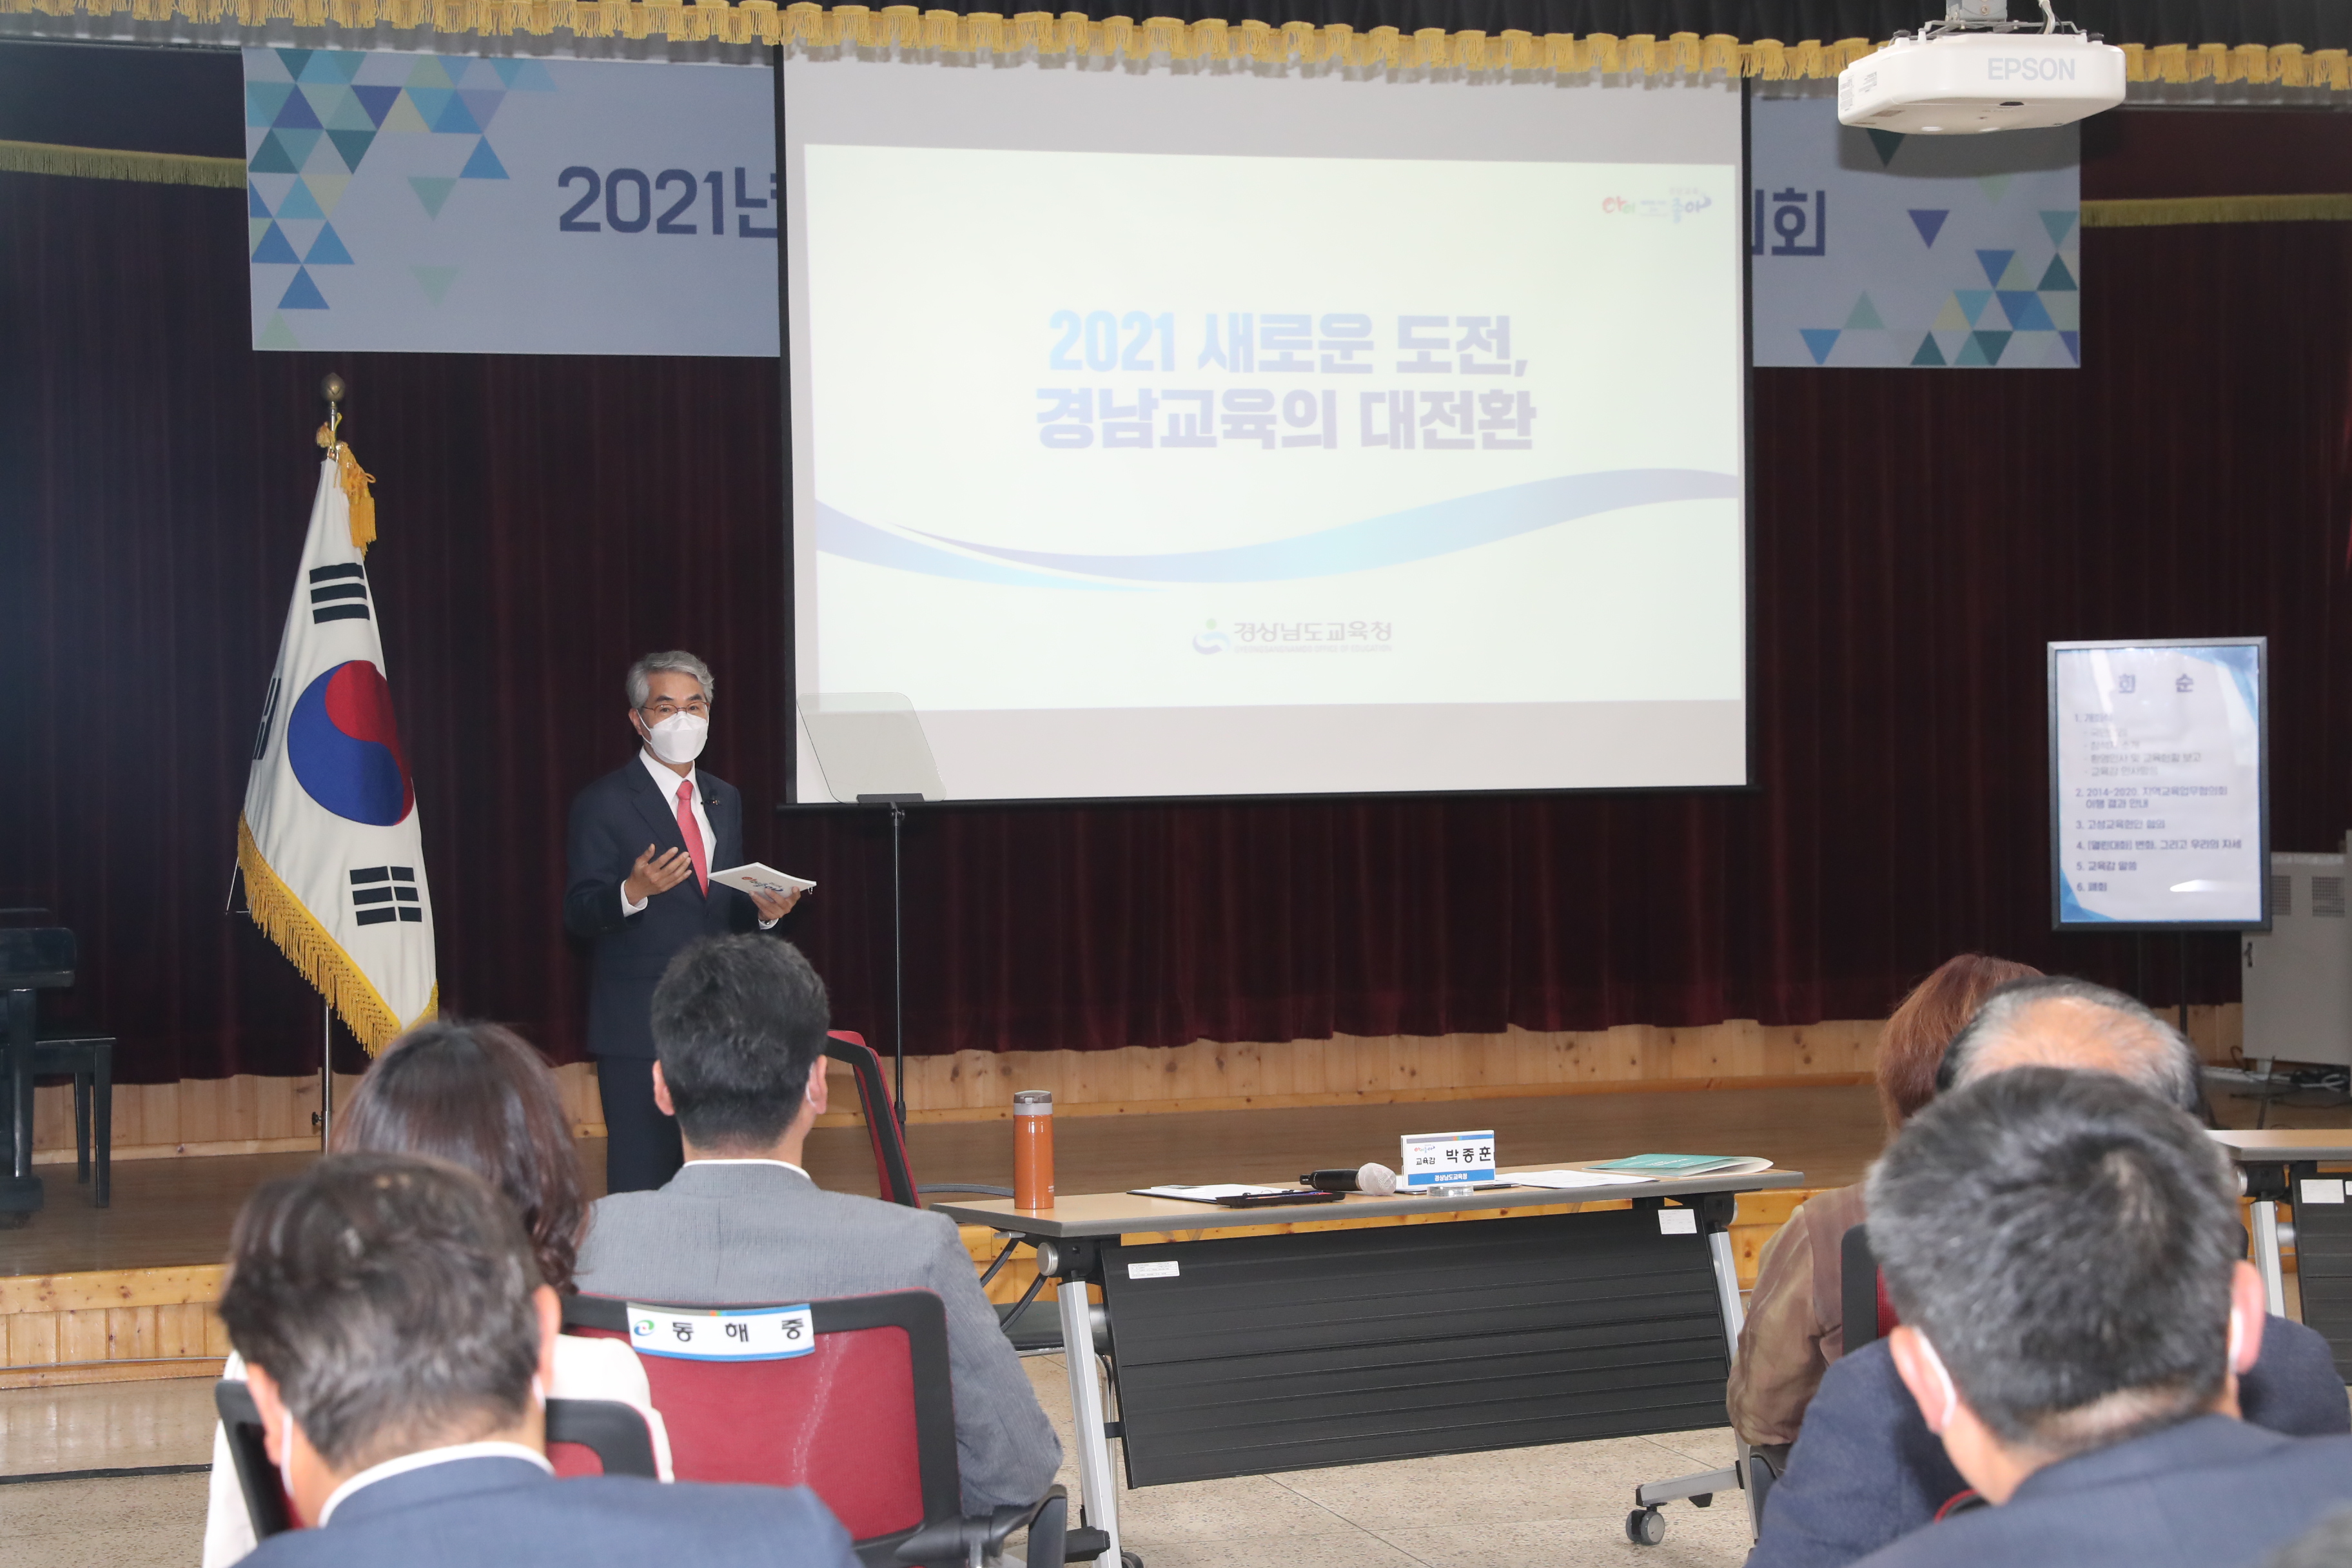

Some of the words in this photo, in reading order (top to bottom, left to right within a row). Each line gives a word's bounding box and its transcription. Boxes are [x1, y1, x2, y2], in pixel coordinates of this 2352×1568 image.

[1988, 57, 2075, 81] EPSON
[1049, 310, 1175, 372] 2021
[1198, 312, 1374, 374] 새로운
[1396, 315, 1528, 377] 도전,
[1036, 387, 1338, 450] 경남교육의
[1360, 388, 1537, 450] 대전환
[1234, 621, 1392, 642] 경상남도교육청
[1434, 1173, 1468, 1182] 경상남도교육청
